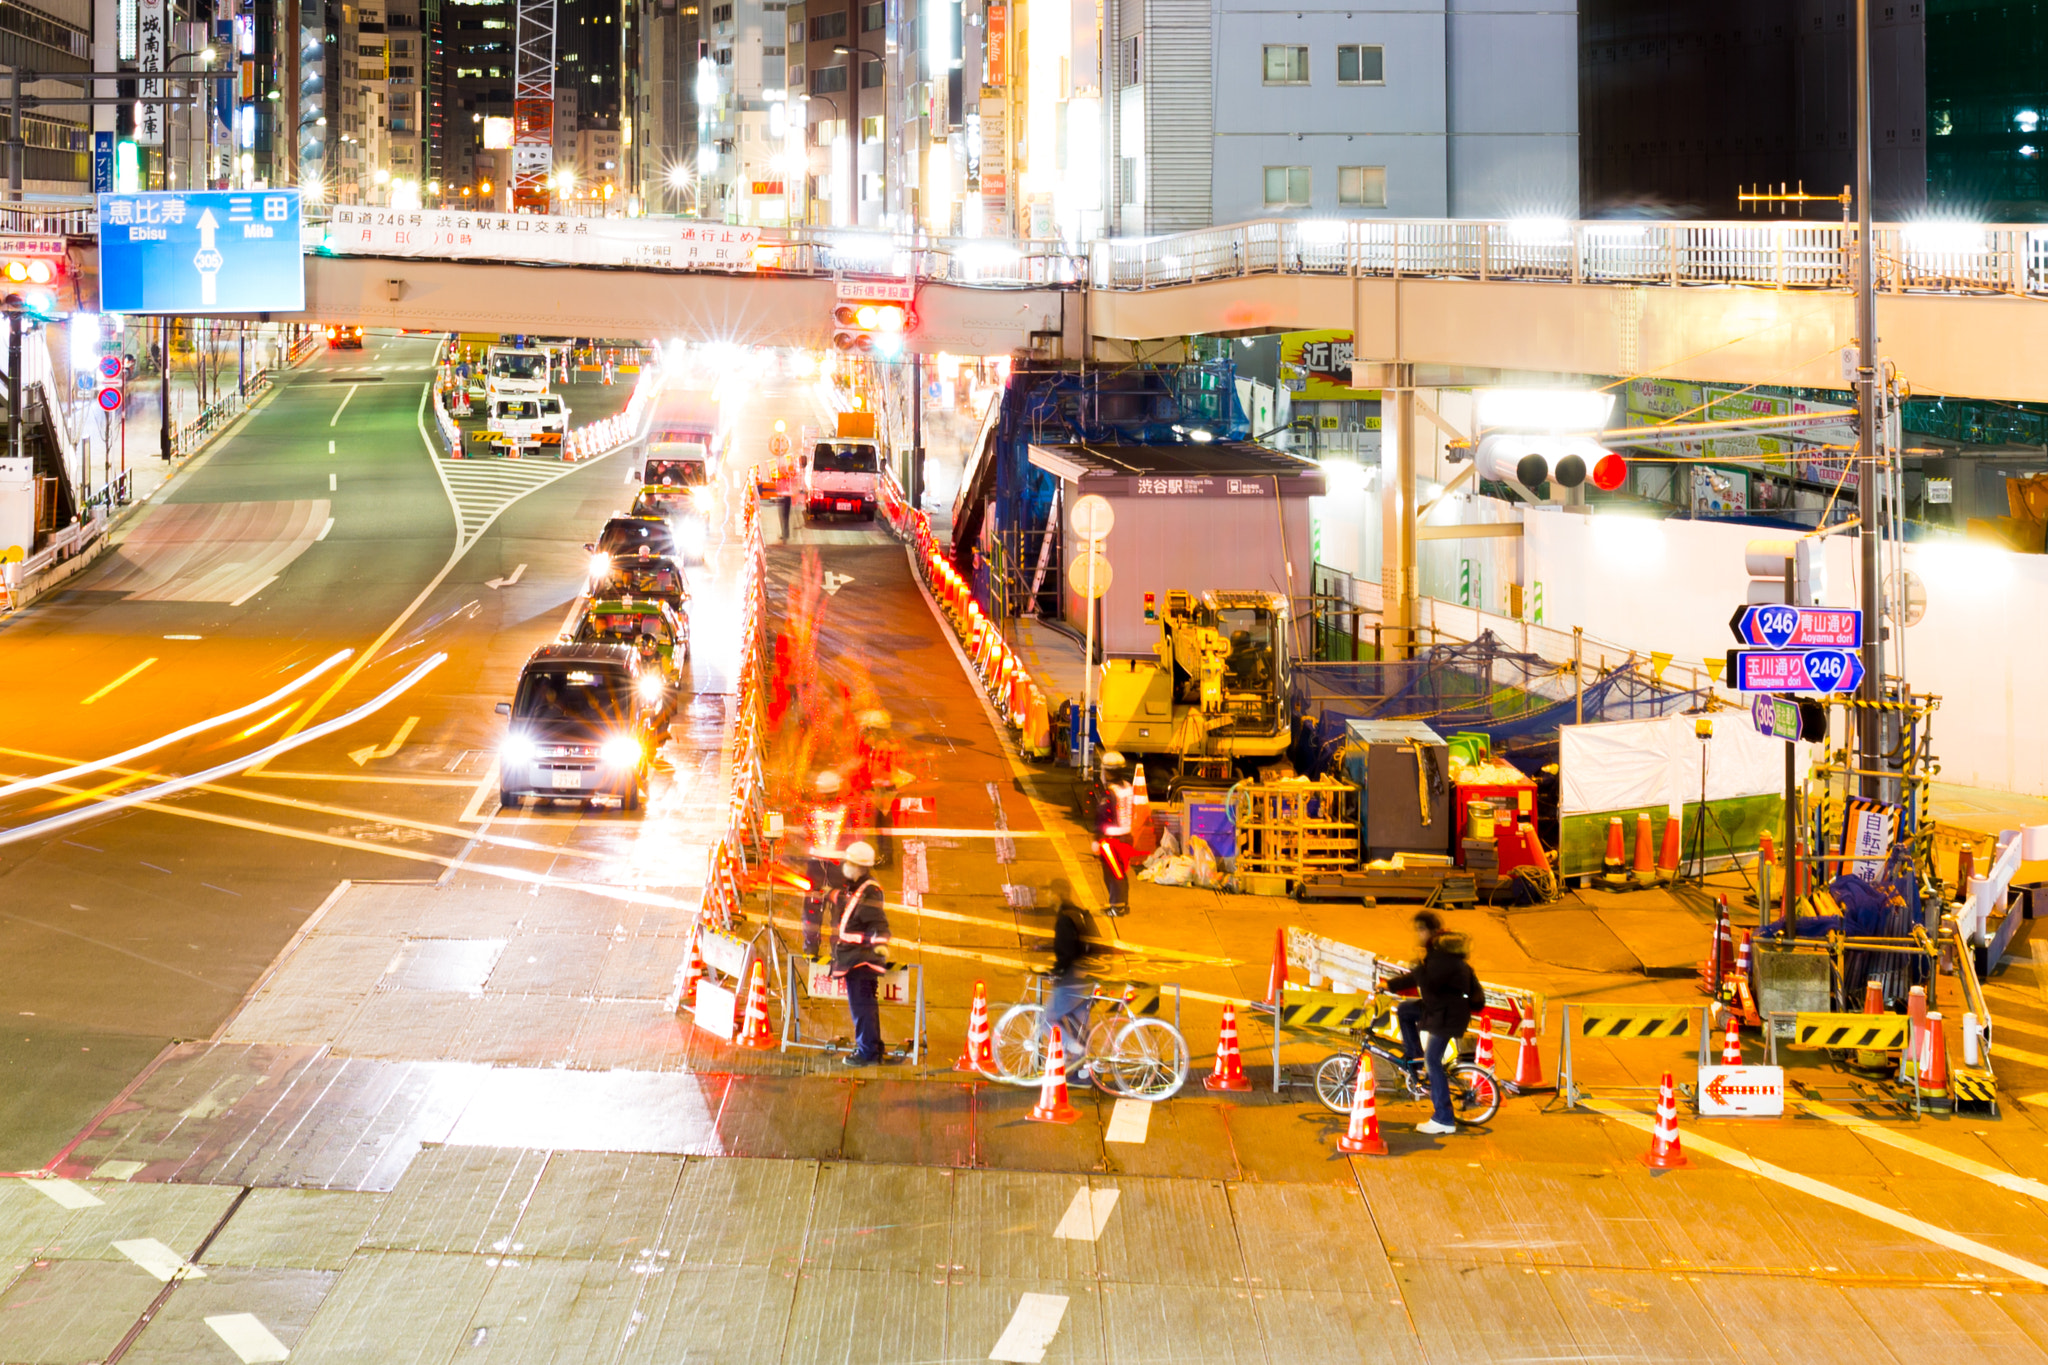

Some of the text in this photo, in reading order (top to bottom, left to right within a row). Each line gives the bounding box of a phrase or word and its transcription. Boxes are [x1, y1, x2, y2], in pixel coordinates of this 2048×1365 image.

[991, 32, 1002, 61] Stella
[142, 14, 161, 139] 城南信用金庫
[109, 200, 186, 226] 恵比寿
[229, 197, 288, 222] 三田
[244, 224, 273, 238] Mita
[339, 211, 588, 235] 国道246号 渋谷駅東口交差点
[129, 227, 167, 240] Ebisu
[681, 228, 754, 243] 通行止め
[0, 241, 62, 252] 折信号設置
[198, 253, 219, 269] 305
[842, 285, 910, 298] 右折信号設置
[1138, 479, 1183, 494] 渋谷駅
[1763, 613, 1793, 633] 246
[1801, 614, 1853, 633] 青山通り
[1801, 634, 1853, 644] Aoyama dori
[1747, 658, 1802, 676] 玉川通り
[1810, 657, 1841, 678] 246
[1749, 676, 1802, 687] Tamagawa dori
[1759, 703, 1775, 728] 305
